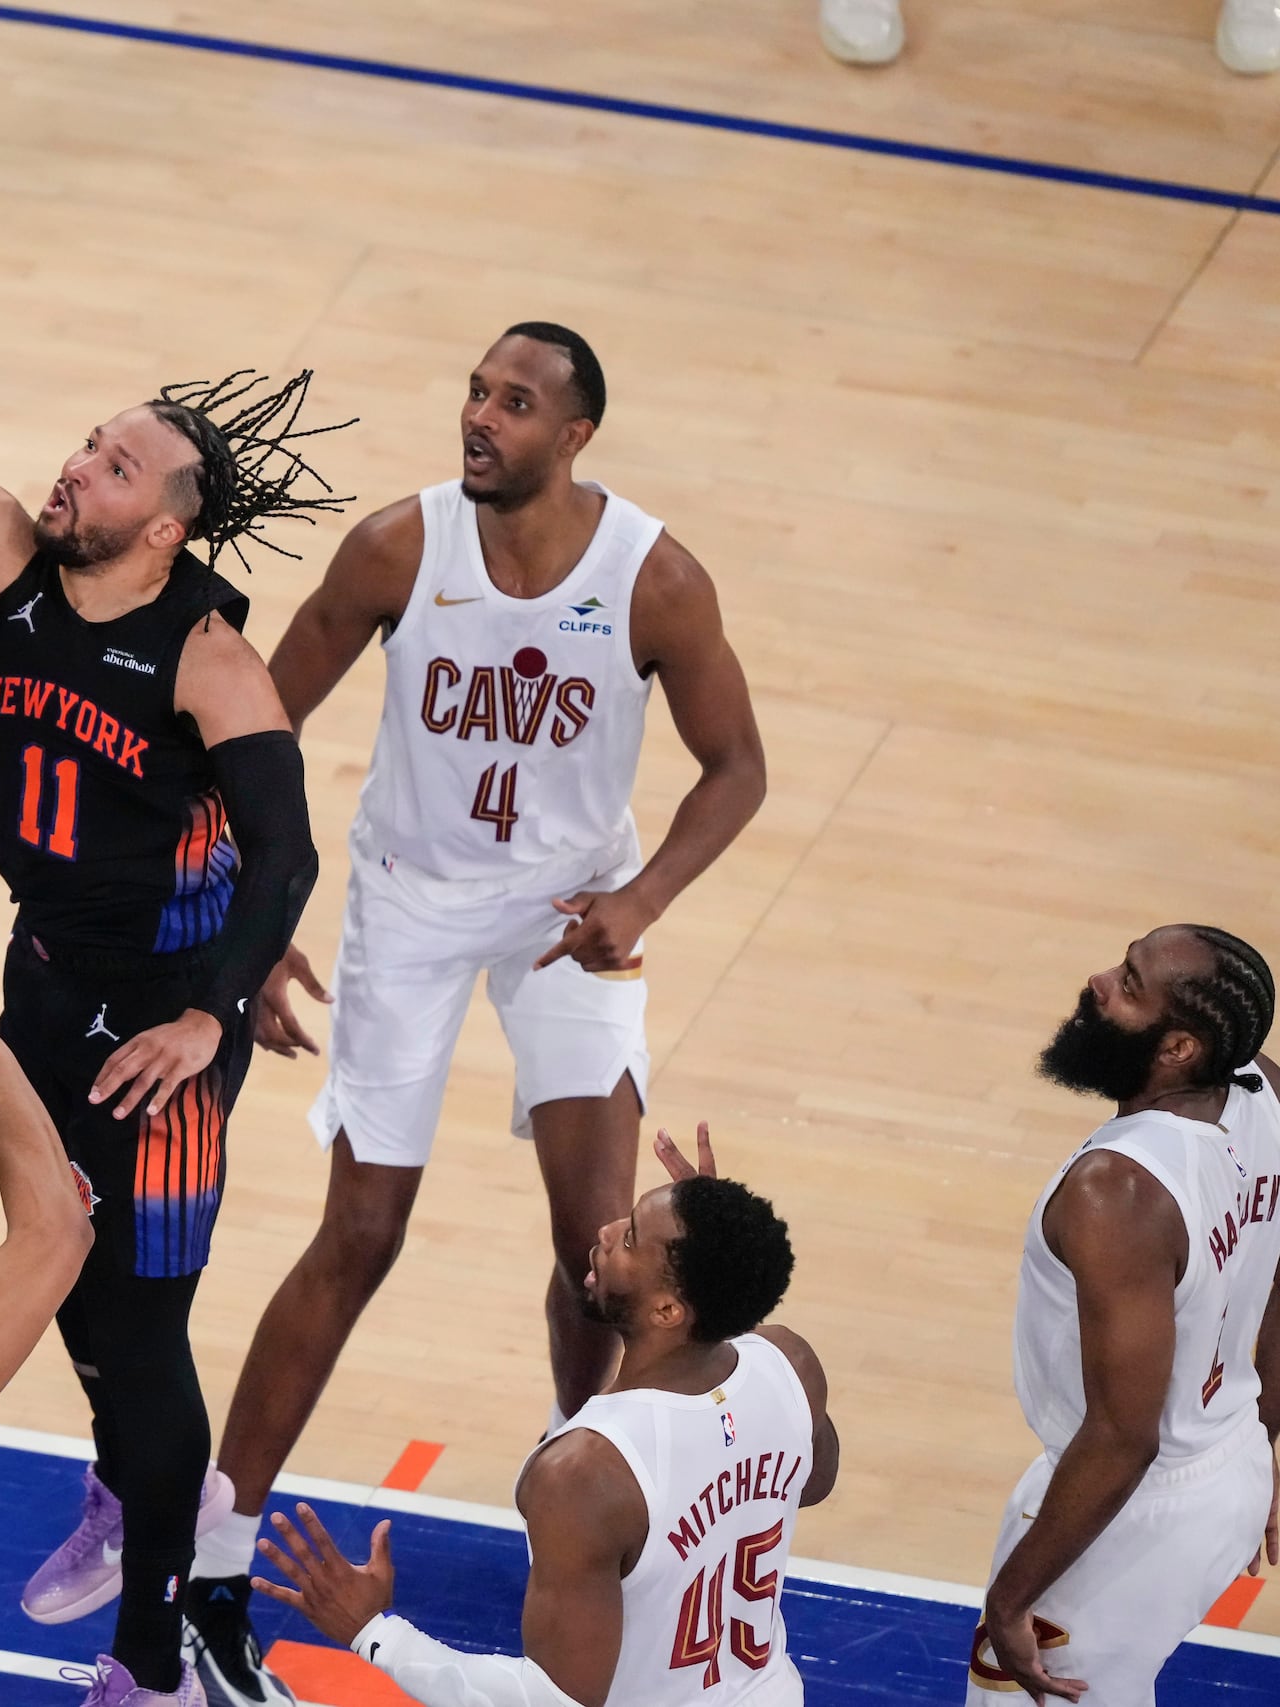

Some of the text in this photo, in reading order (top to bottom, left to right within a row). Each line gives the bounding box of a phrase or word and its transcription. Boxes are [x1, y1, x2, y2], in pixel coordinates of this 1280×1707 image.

[102, 653, 157, 675] abu dhabi
[558, 620, 612, 636] CLIFFS
[56, 687, 150, 779] YORK
[420, 655, 596, 748] CAVS
[17, 743, 79, 860] 11
[469, 760, 519, 843] 4
[666, 1450, 802, 1562] MITCHELL
[668, 1516, 784, 1691] 45
